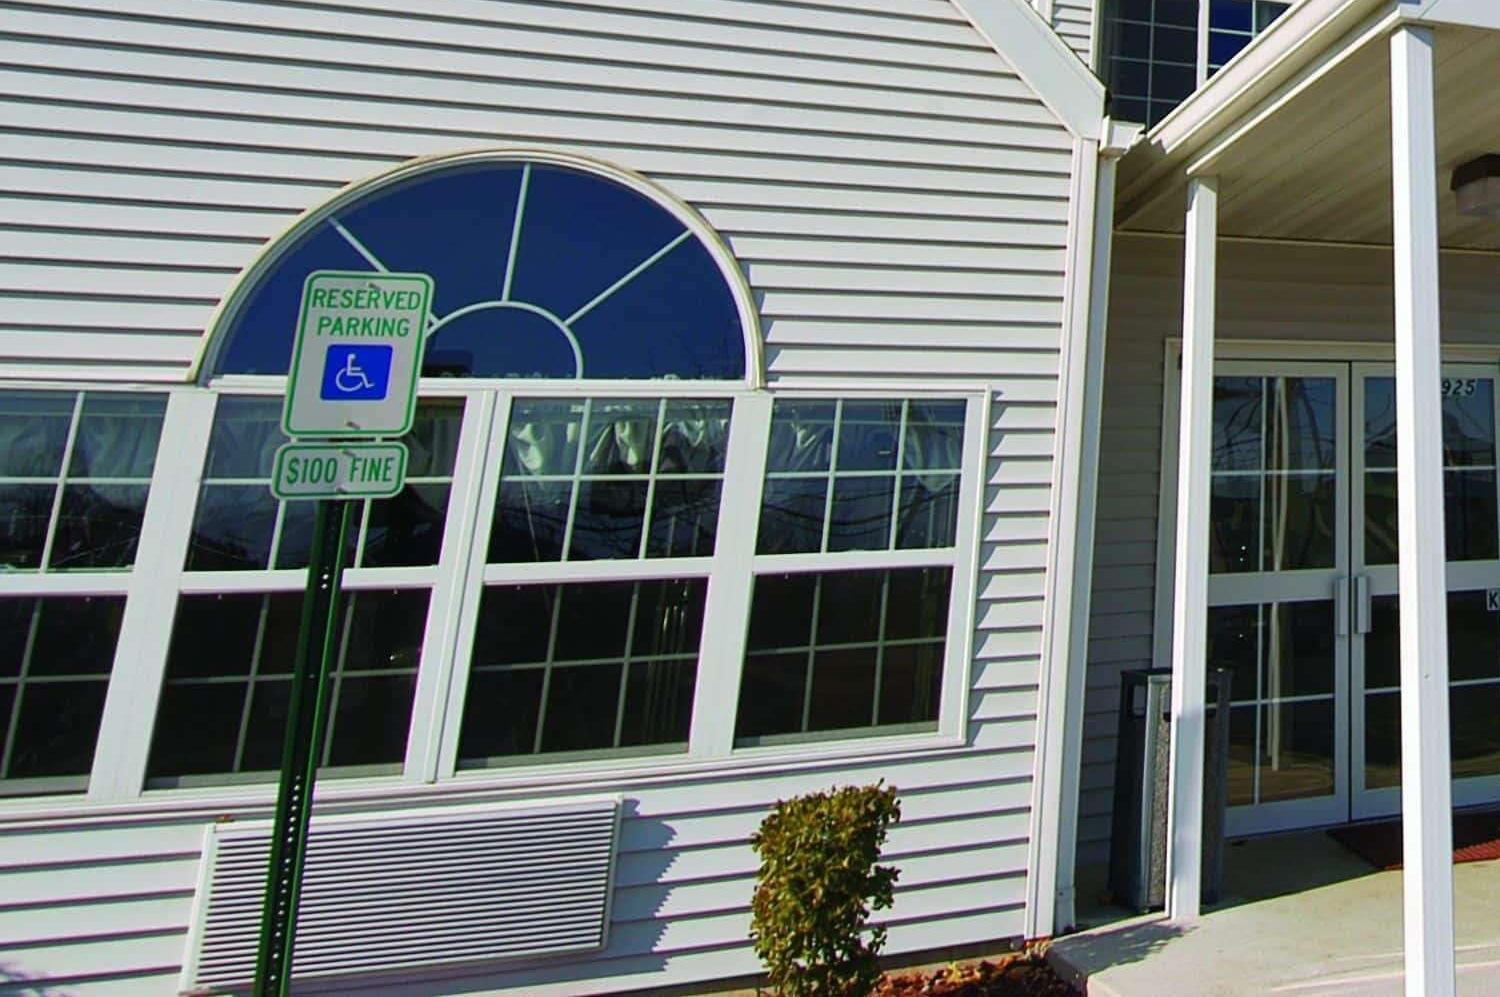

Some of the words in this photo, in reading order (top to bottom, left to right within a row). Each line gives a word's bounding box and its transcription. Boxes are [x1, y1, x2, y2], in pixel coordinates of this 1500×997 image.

[311, 288, 421, 311] RESERVED
[316, 316, 411, 337] PARKING
[286, 457, 338, 484] $100
[349, 457, 396, 483] FINE
